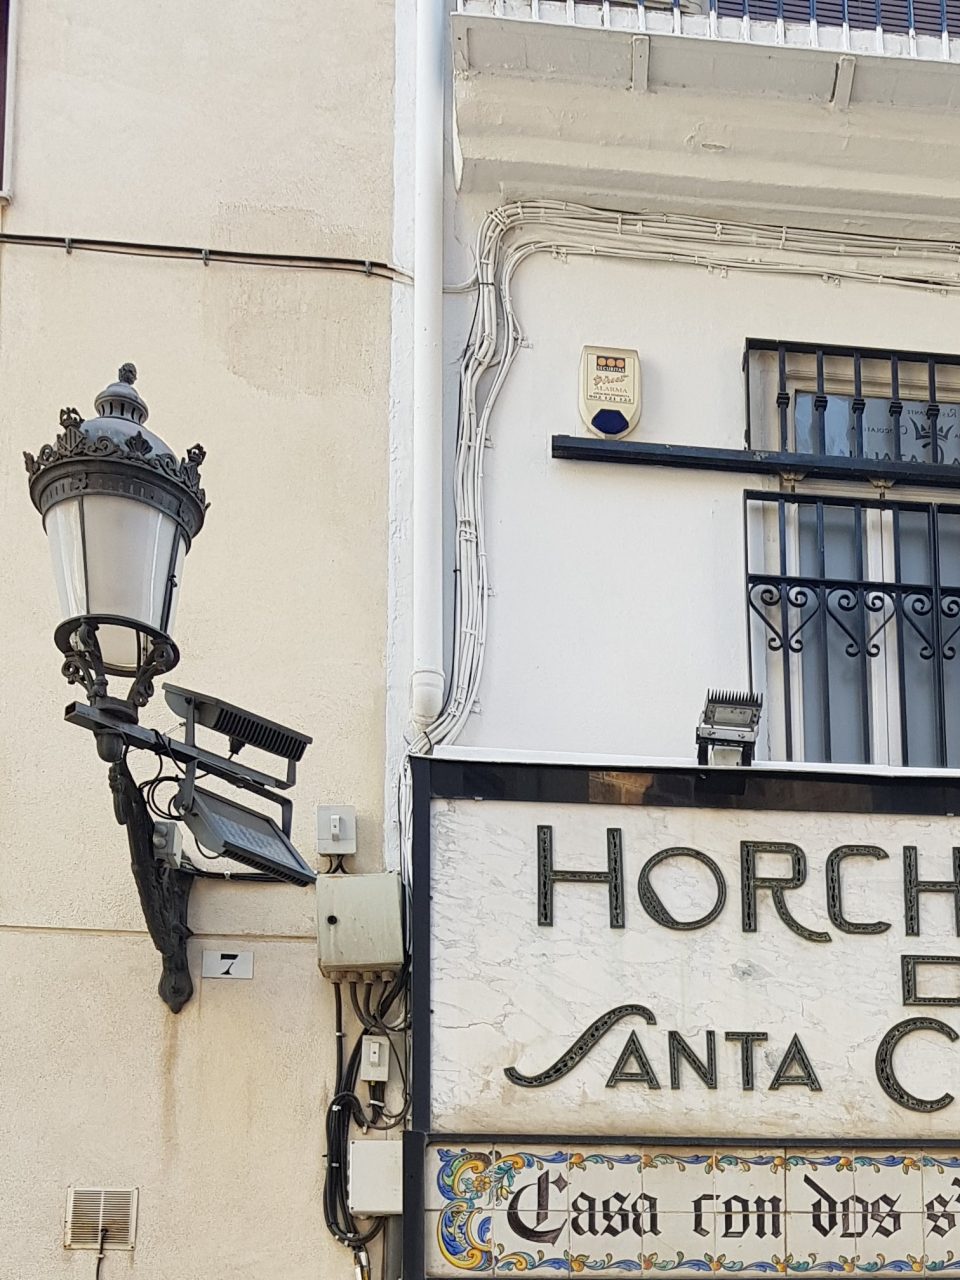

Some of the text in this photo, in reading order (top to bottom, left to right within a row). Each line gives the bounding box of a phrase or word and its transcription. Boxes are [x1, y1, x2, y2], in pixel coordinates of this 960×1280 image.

[594, 386, 628, 394] ALARMA
[220, 953, 239, 976] 7
[503, 1004, 822, 1092] SANTA
[506, 1168, 662, 1246] Casa
[692, 1194, 782, 1239] con
[803, 1174, 902, 1238] dos
